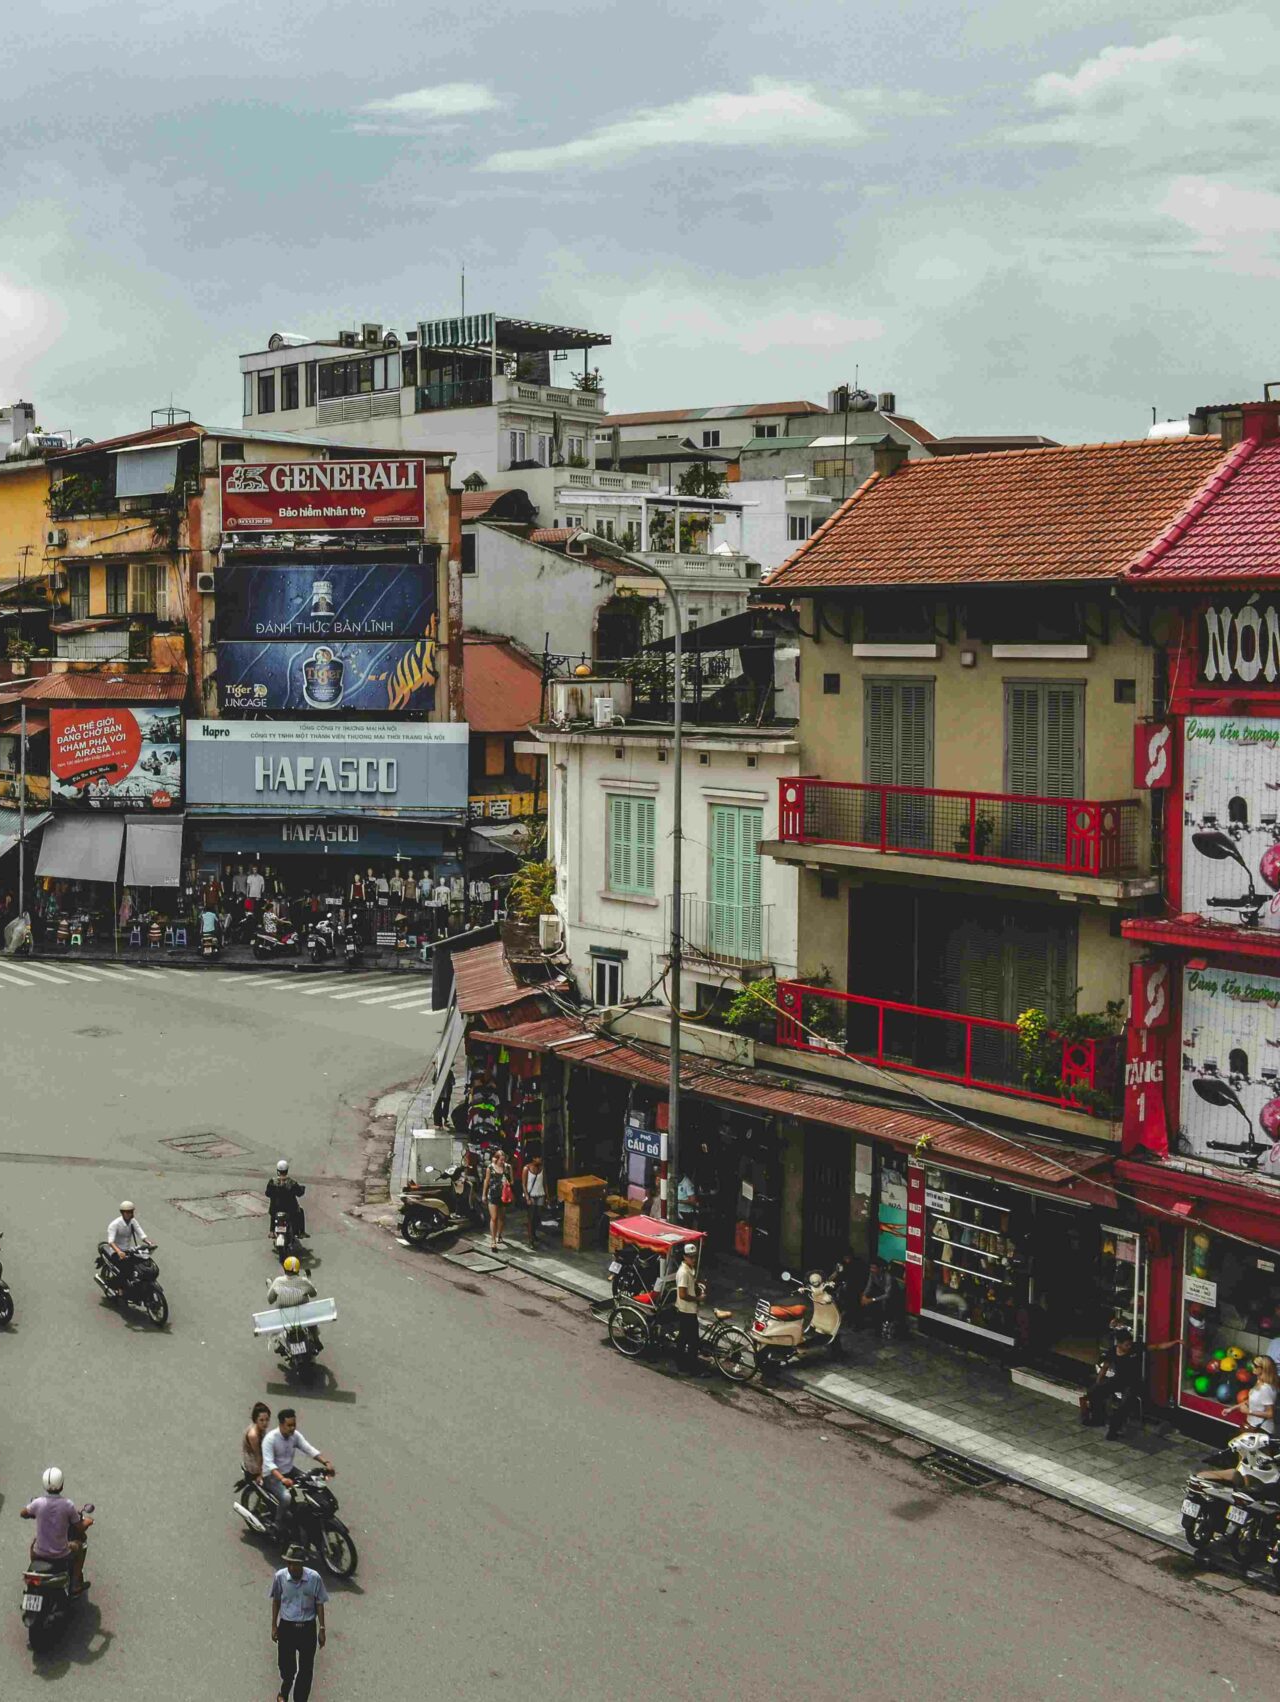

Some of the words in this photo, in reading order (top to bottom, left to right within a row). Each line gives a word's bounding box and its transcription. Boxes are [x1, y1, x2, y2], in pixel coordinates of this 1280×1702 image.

[270, 462, 418, 492] GENERALI
[323, 506, 346, 517] Nhân
[348, 506, 366, 518] thọ
[256, 621, 292, 634] ĐÁNH
[296, 619, 330, 633] THỨC
[334, 620, 363, 633] BẢN
[364, 619, 394, 632] LĨNH
[306, 666, 340, 685] Tiger
[225, 684, 252, 697] Tiger
[57, 732, 81, 744] ĐANG
[202, 725, 230, 739] Hapro
[60, 741, 87, 753] KHÁM
[89, 737, 107, 749] PHÁ
[75, 745, 111, 758] AIRASIA
[255, 756, 397, 792] HAFASCO
[282, 824, 358, 842] HAFASCO
[1136, 1093, 1145, 1122] 1
